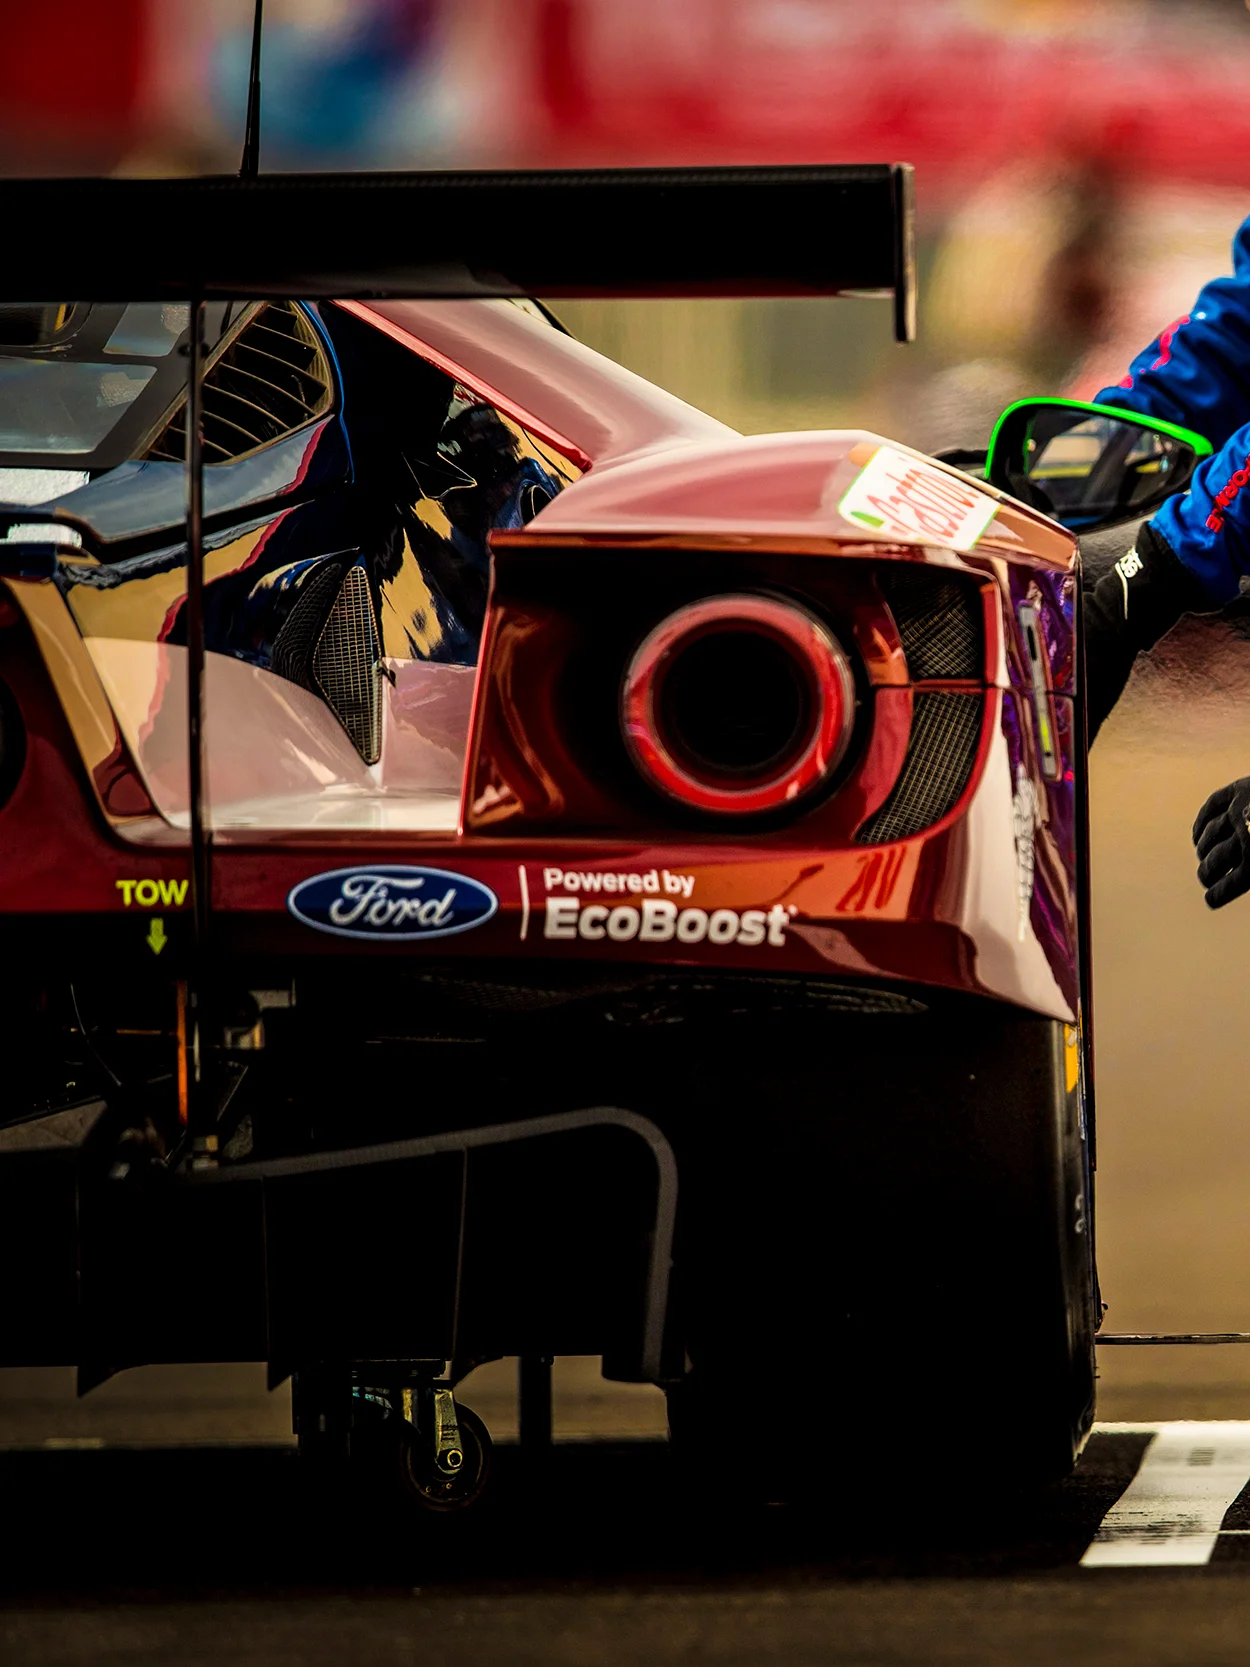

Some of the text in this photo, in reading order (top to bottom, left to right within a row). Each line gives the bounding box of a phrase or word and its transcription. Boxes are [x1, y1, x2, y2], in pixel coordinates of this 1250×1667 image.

[115, 879, 189, 907] TOW
[329, 874, 458, 927] Ford
[544, 867, 695, 898] Powered by
[544, 896, 791, 947] EcoBoost
